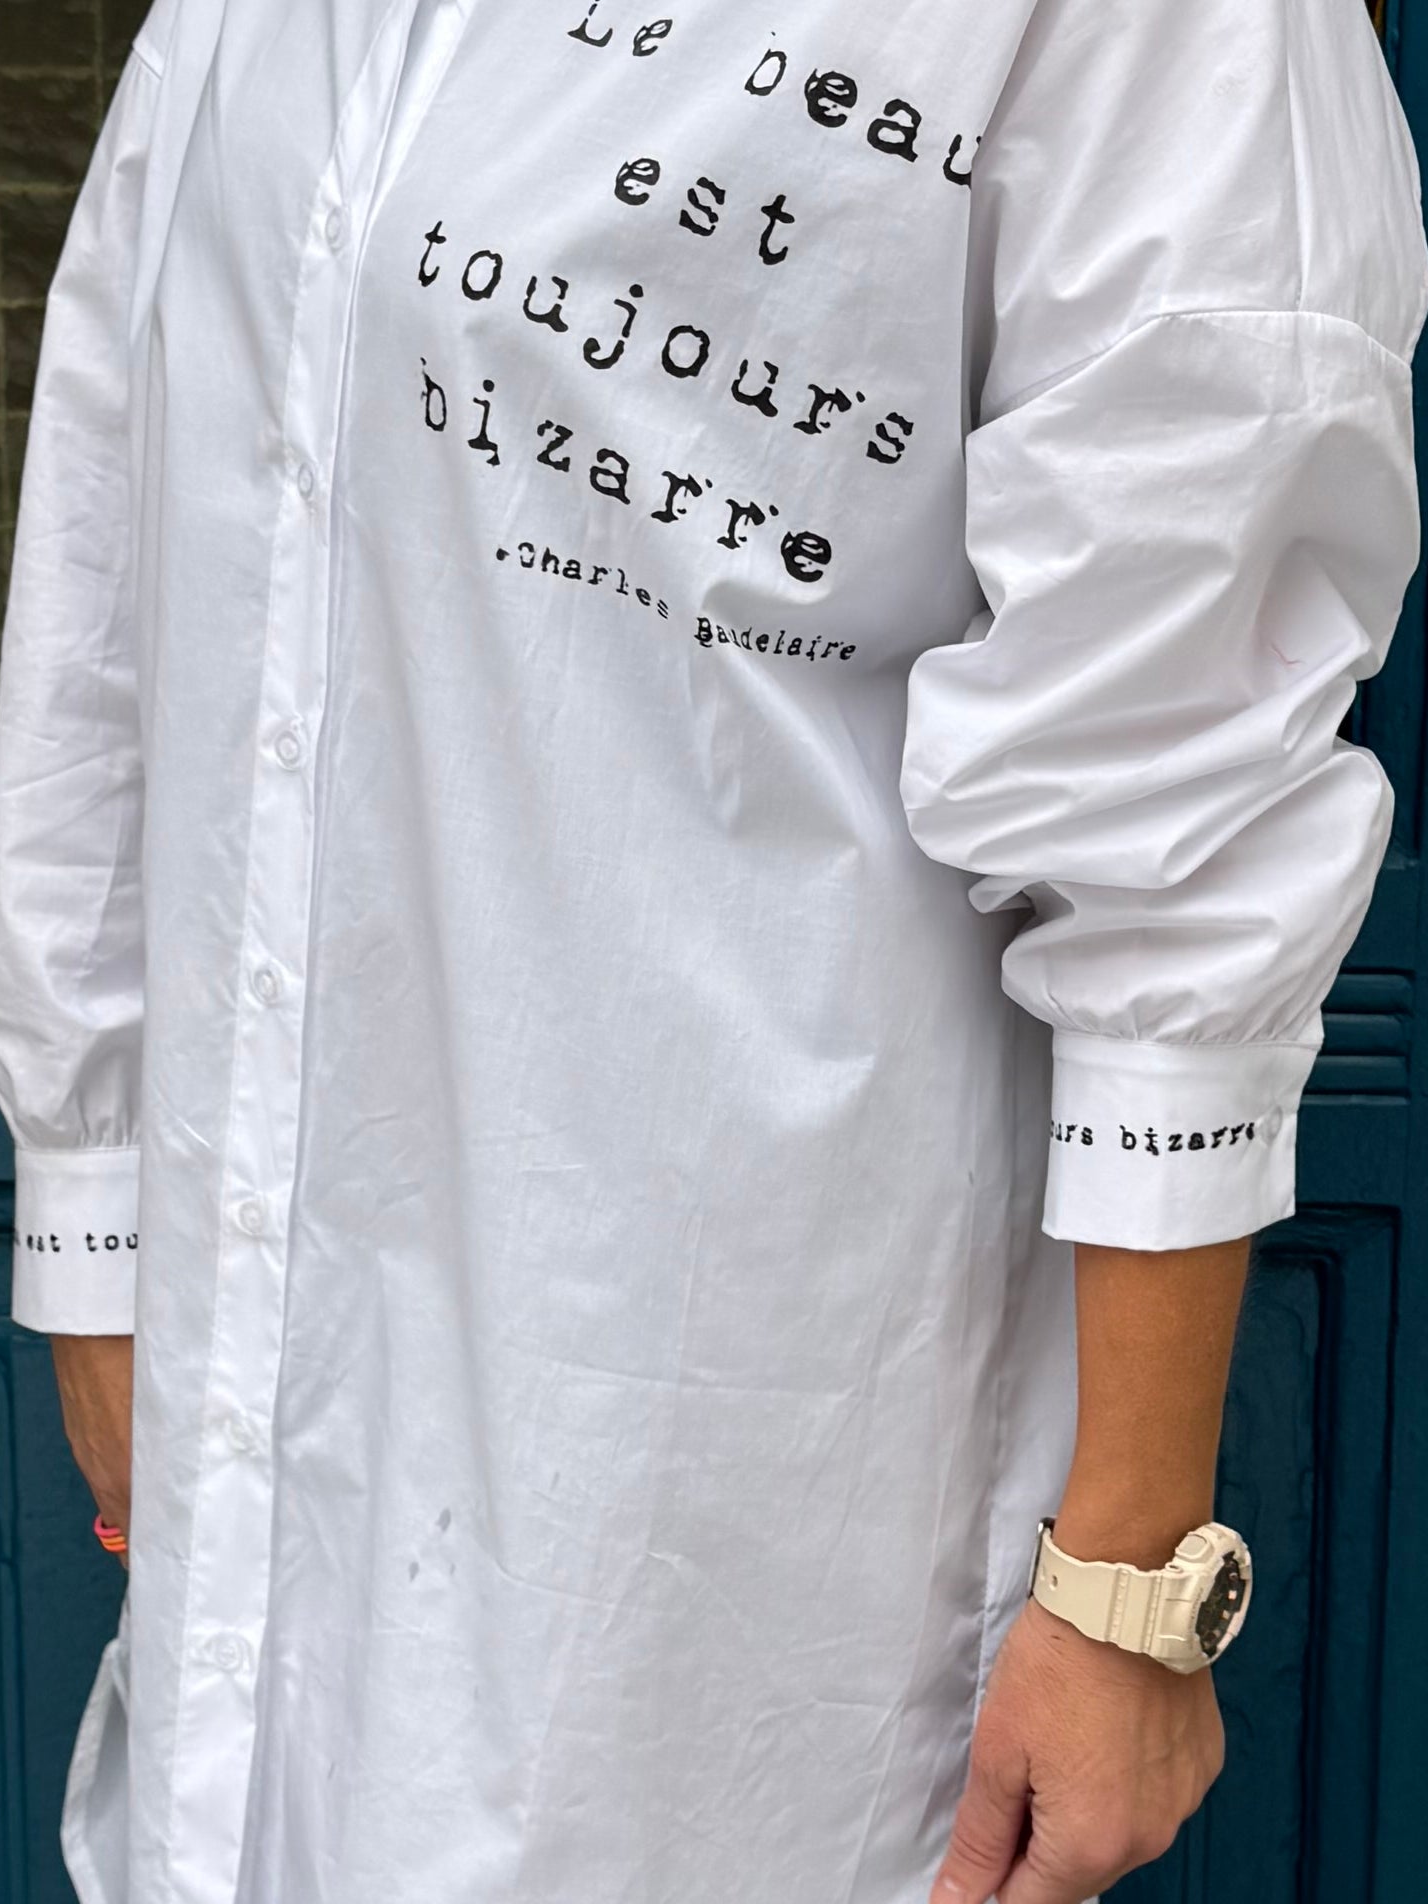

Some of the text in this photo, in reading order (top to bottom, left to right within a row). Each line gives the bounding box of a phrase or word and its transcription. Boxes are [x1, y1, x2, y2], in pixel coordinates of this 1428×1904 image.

[613, 157, 796, 267] est
[417, 220, 916, 466] toujours
[419, 356, 833, 584] bizarre
